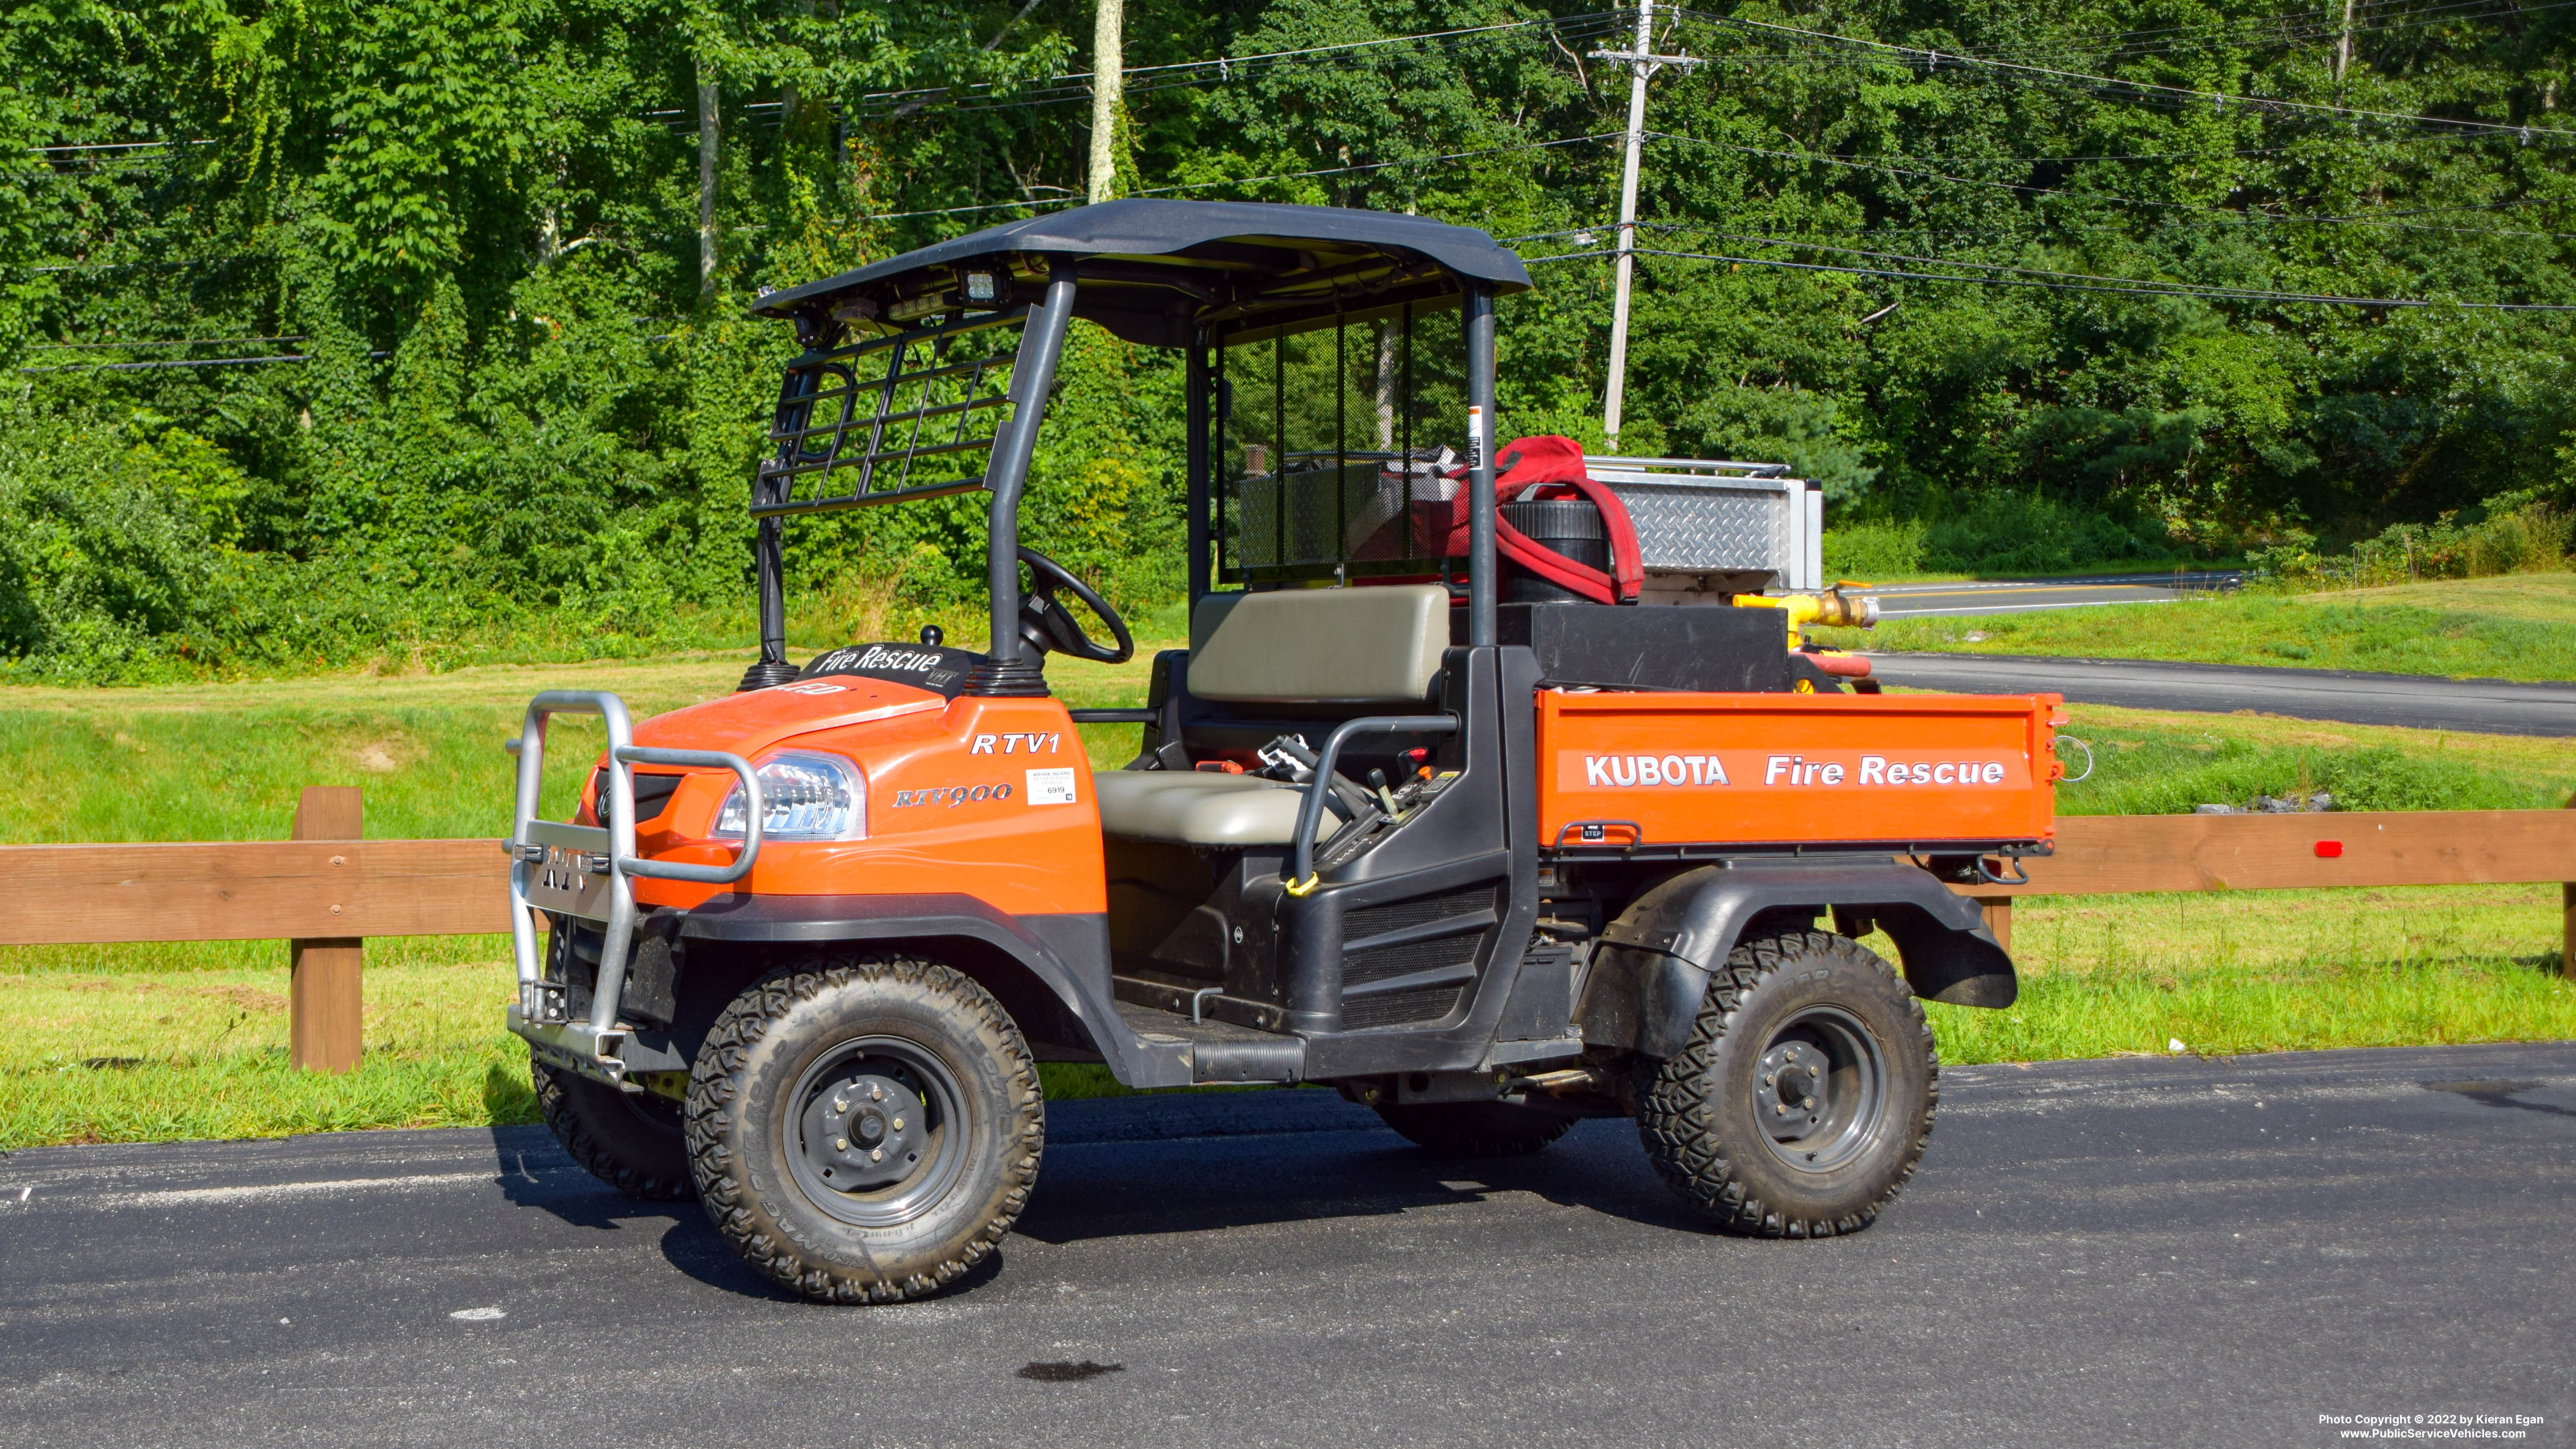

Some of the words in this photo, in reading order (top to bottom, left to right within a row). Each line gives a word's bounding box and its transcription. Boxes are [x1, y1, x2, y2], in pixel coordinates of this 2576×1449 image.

[814, 648, 859, 673] Fire
[854, 645, 942, 672] Rescue
[970, 733, 1060, 754] RTV1
[1585, 755, 1729, 787] KUBOTA
[1764, 754, 1844, 785] Fire
[1858, 754, 2004, 785] Rescue
[893, 783, 1013, 808] RTV900
[744, 1039, 791, 1125] ROAD
[982, 1057, 1012, 1116] OTR
[742, 1130, 768, 1193] OFF
[761, 1199, 819, 1252] MAG
